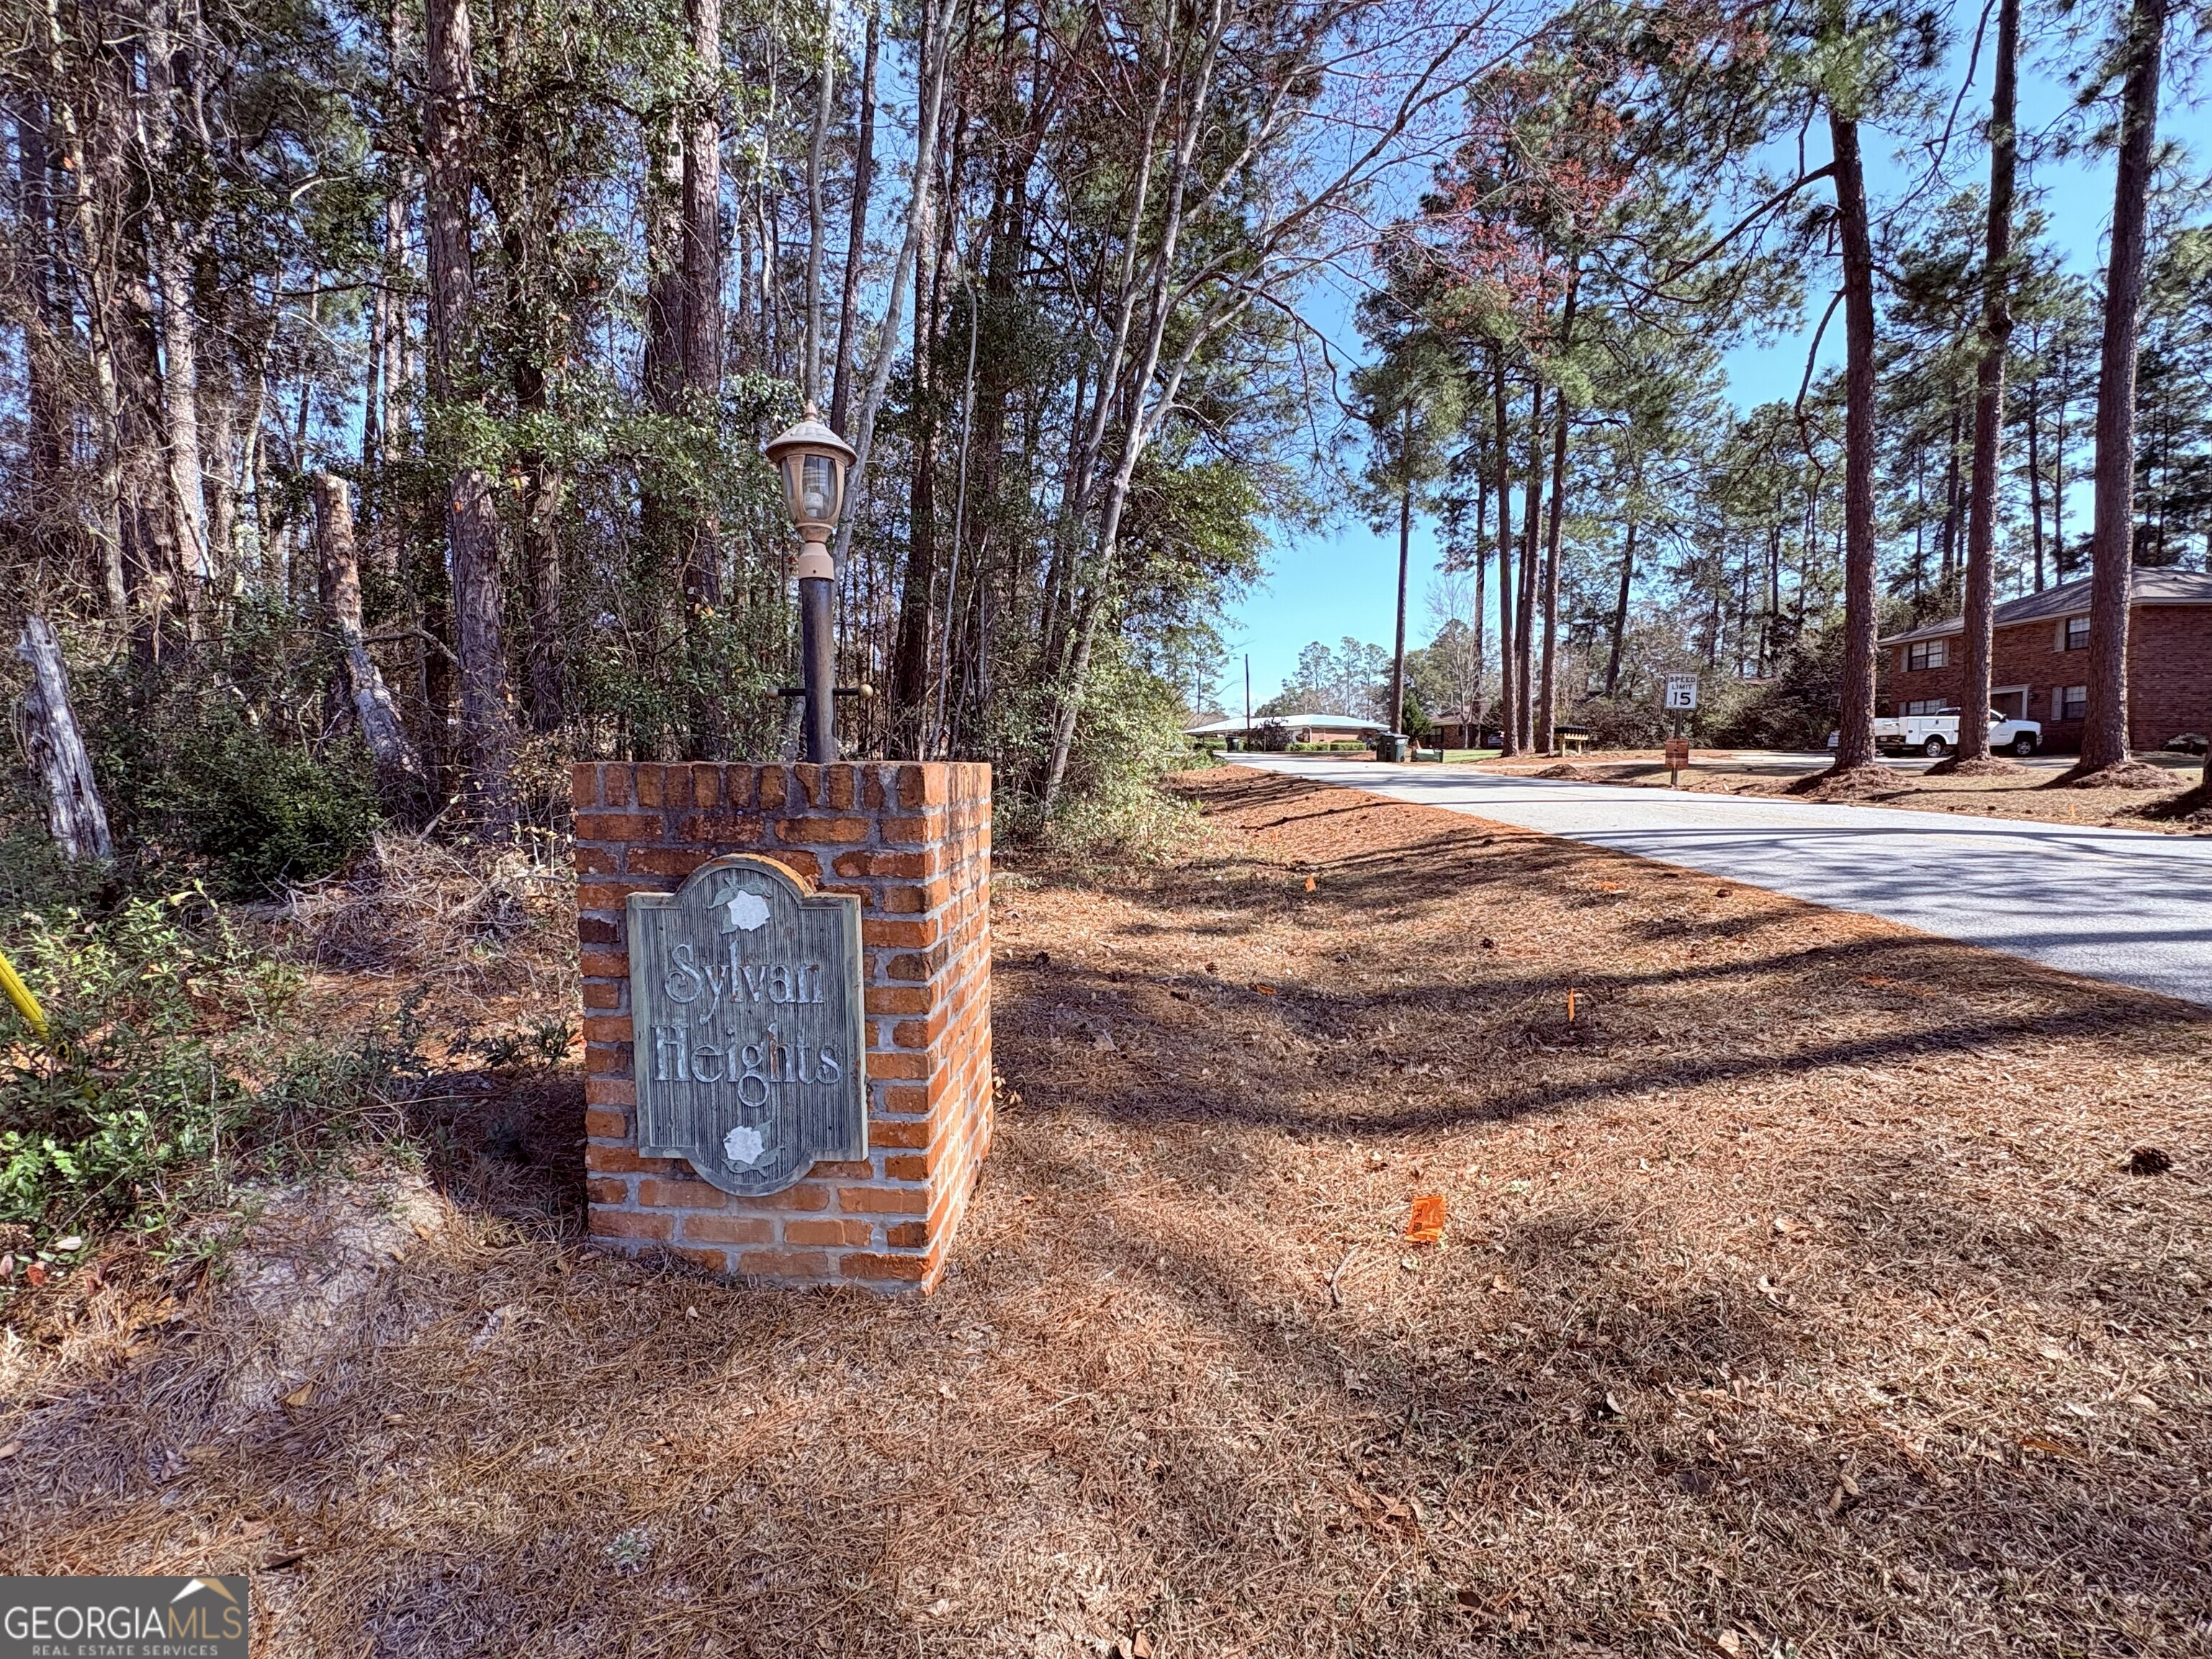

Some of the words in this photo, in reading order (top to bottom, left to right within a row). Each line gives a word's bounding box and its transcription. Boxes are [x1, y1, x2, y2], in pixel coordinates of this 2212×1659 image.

[1673, 692, 1691, 706] 15
[665, 940, 824, 1024] Sylvan
[650, 1022, 843, 1107] Heights
